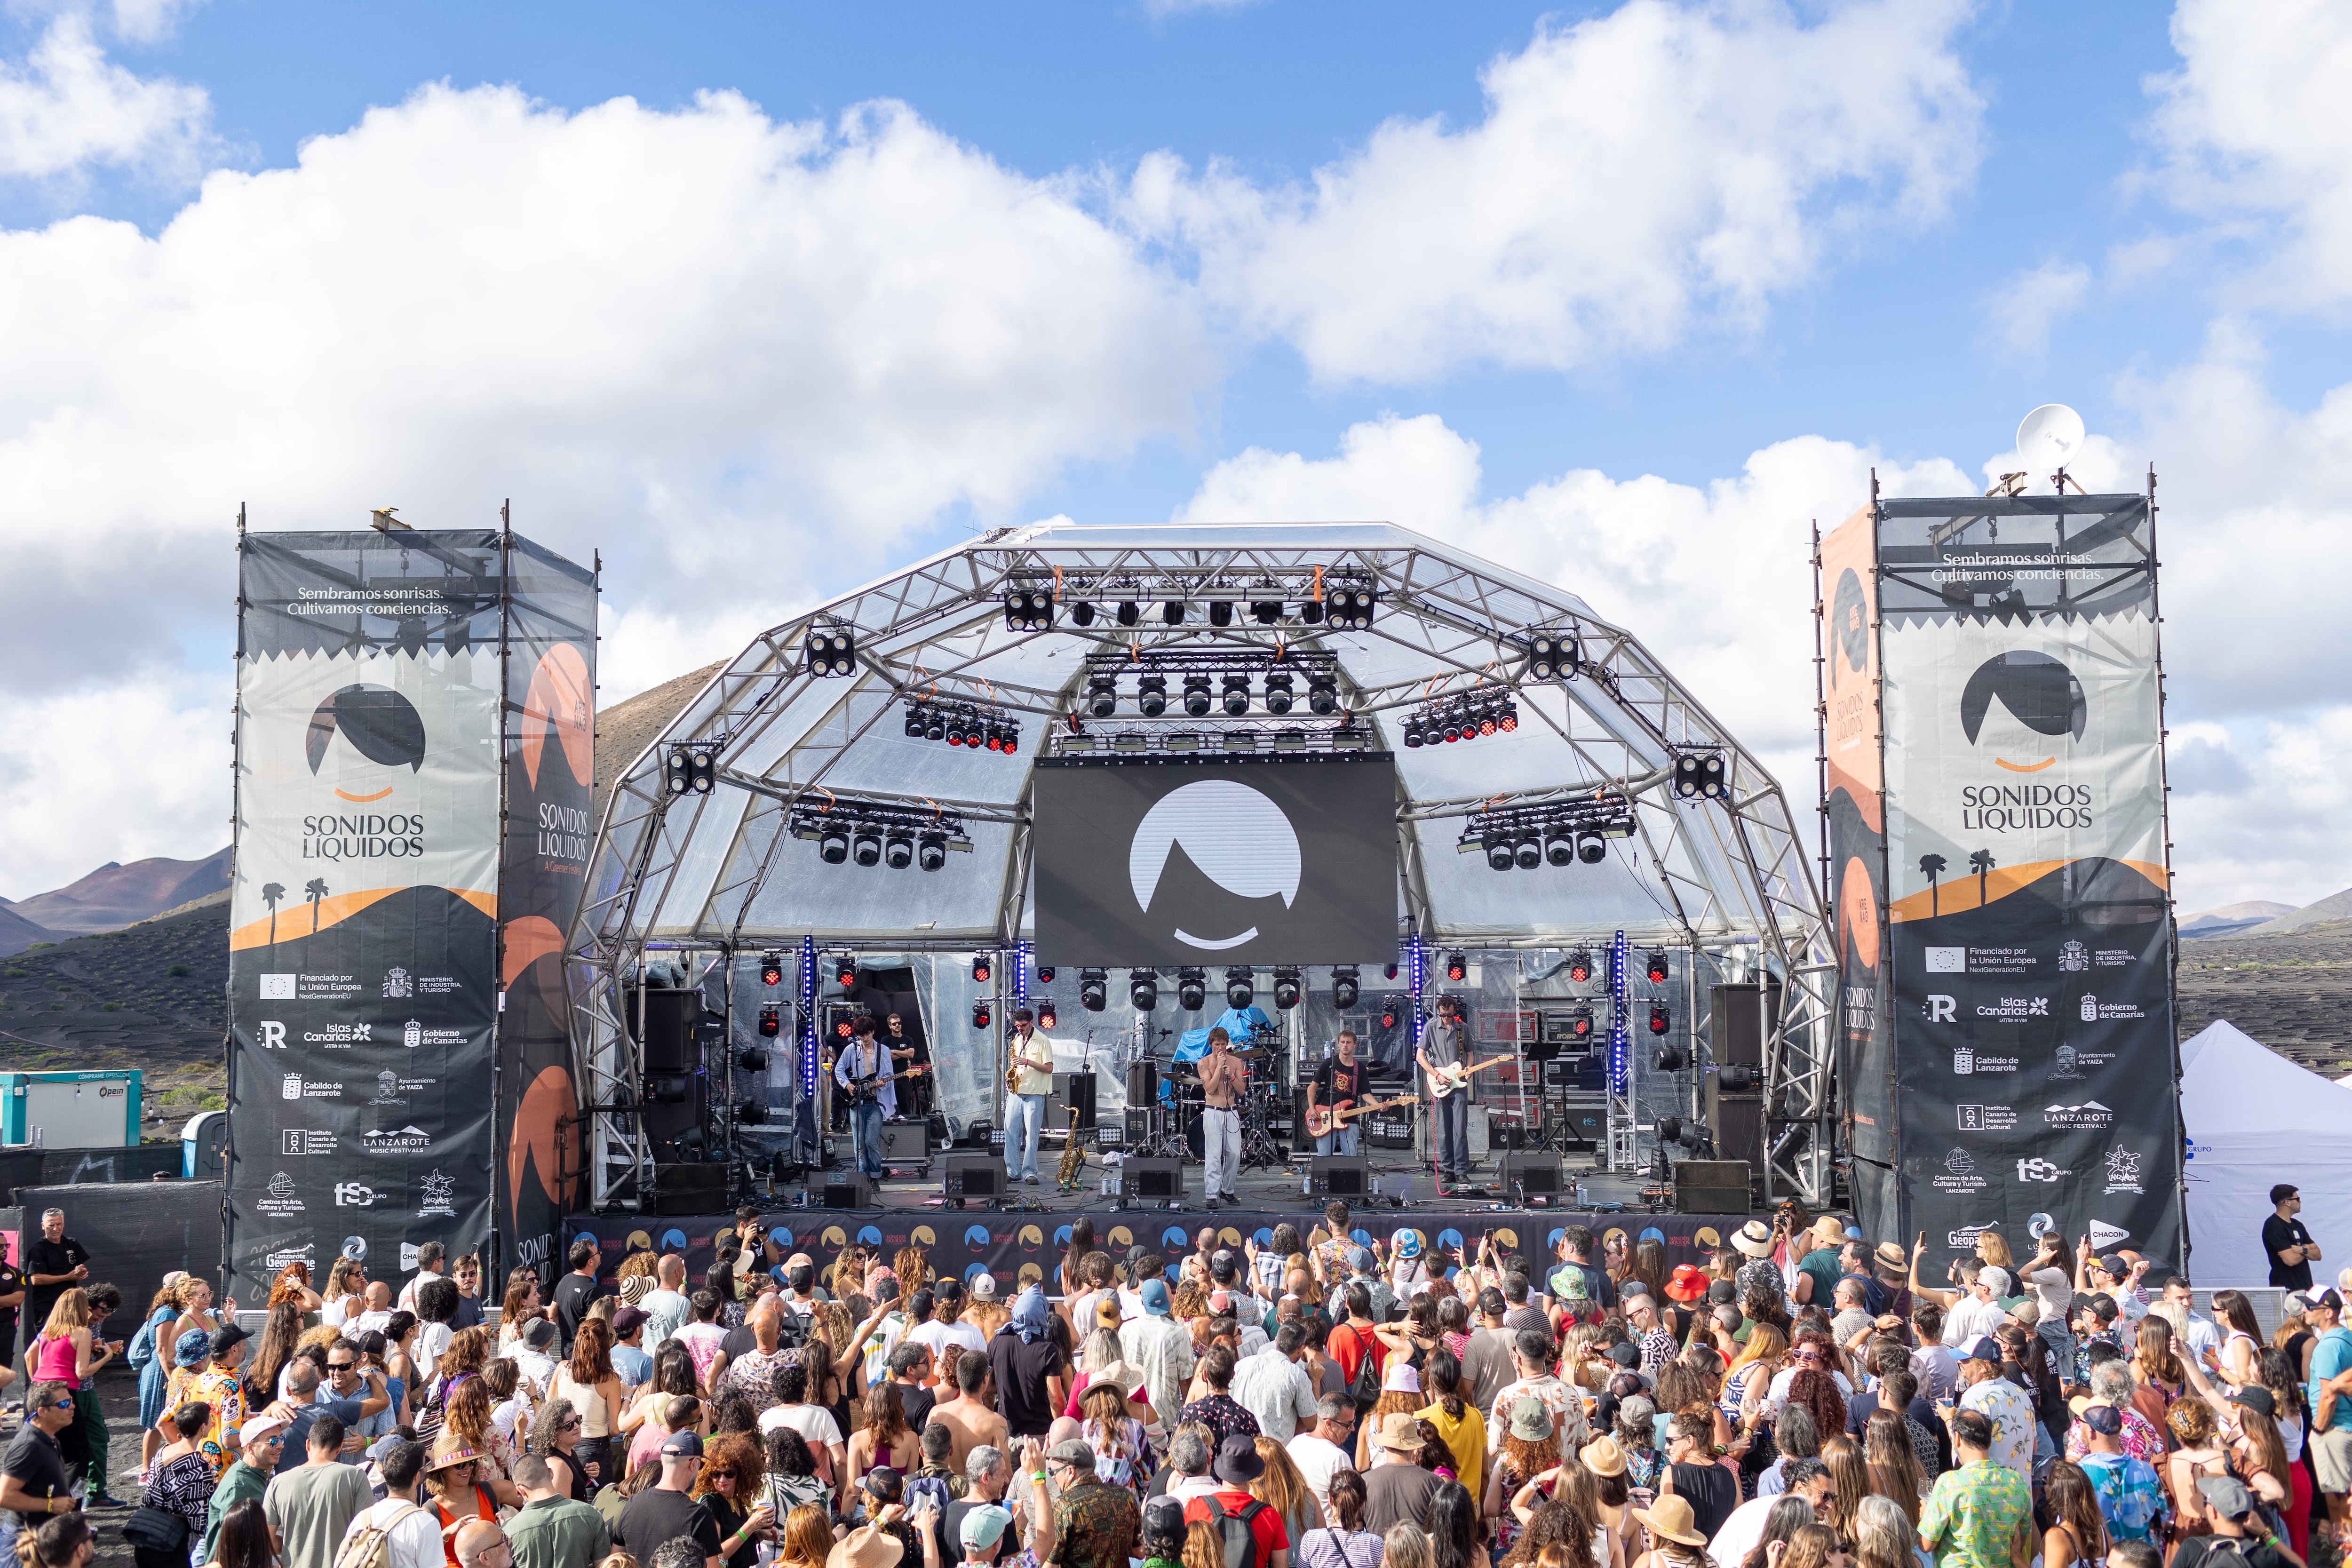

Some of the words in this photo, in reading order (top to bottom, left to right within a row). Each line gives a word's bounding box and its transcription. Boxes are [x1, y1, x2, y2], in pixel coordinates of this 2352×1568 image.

[1943, 552, 2031, 565] Sembramos
[2034, 552, 2095, 565] sonrisas.
[1931, 569, 2013, 582] Cultivamos
[2016, 568, 2104, 581] conciencias.
[298, 587, 381, 600] Sembramos
[383, 588, 444, 599] sonrisas.
[287, 602, 362, 614] Cultivamos
[366, 603, 452, 615] conciencias.
[1849, 604, 1859, 620] ARE
[574, 700, 586, 716] ARE
[1963, 785, 2091, 808] SONIDOS
[539, 802, 588, 836] SONIDOS
[303, 815, 424, 837] SONIDOS
[545, 860, 549, 871] A
[550, 860, 569, 873] Greener
[1846, 987, 1874, 1008] SONIDOS
[2001, 997, 2027, 1007] Islas
[1976, 1006, 2027, 1015] Canarias
[326, 1023, 351, 1033] Islas
[303, 1032, 351, 1042] Canarias
[2044, 1113, 2113, 1122] LANZAROTE
[2108, 1174, 2137, 1182] LANZAROTE
[1948, 1231, 1979, 1248] Geopa
